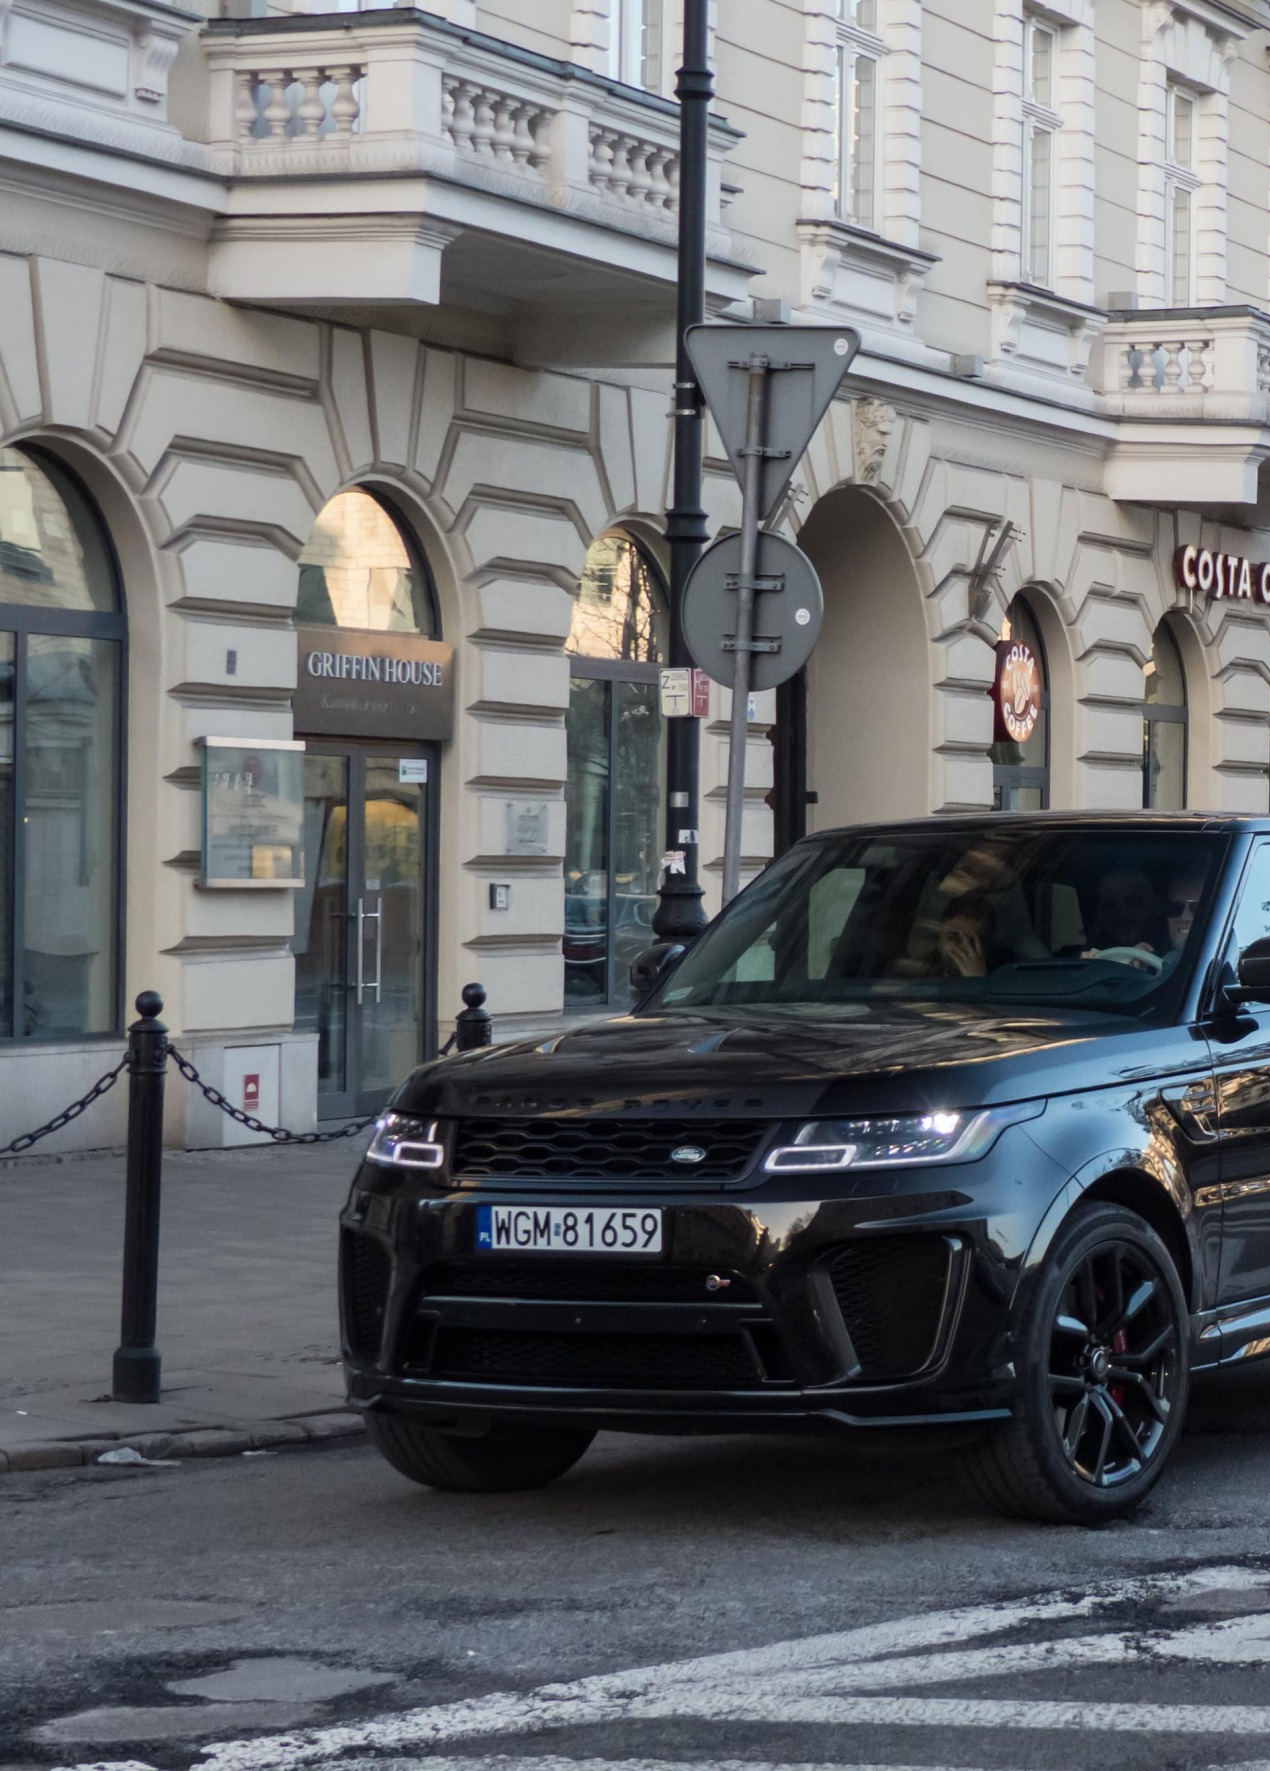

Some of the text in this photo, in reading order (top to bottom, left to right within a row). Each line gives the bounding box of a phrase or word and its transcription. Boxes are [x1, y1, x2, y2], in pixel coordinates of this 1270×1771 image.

[1183, 545, 1250, 600] COSTA
[308, 651, 443, 686] GRIFFIN HOUSE
[1006, 644, 1035, 674] COSTA
[1004, 702, 1038, 738] COFFEE
[480, 1232, 491, 1242] PL
[495, 1210, 658, 1248] WGM 81659
